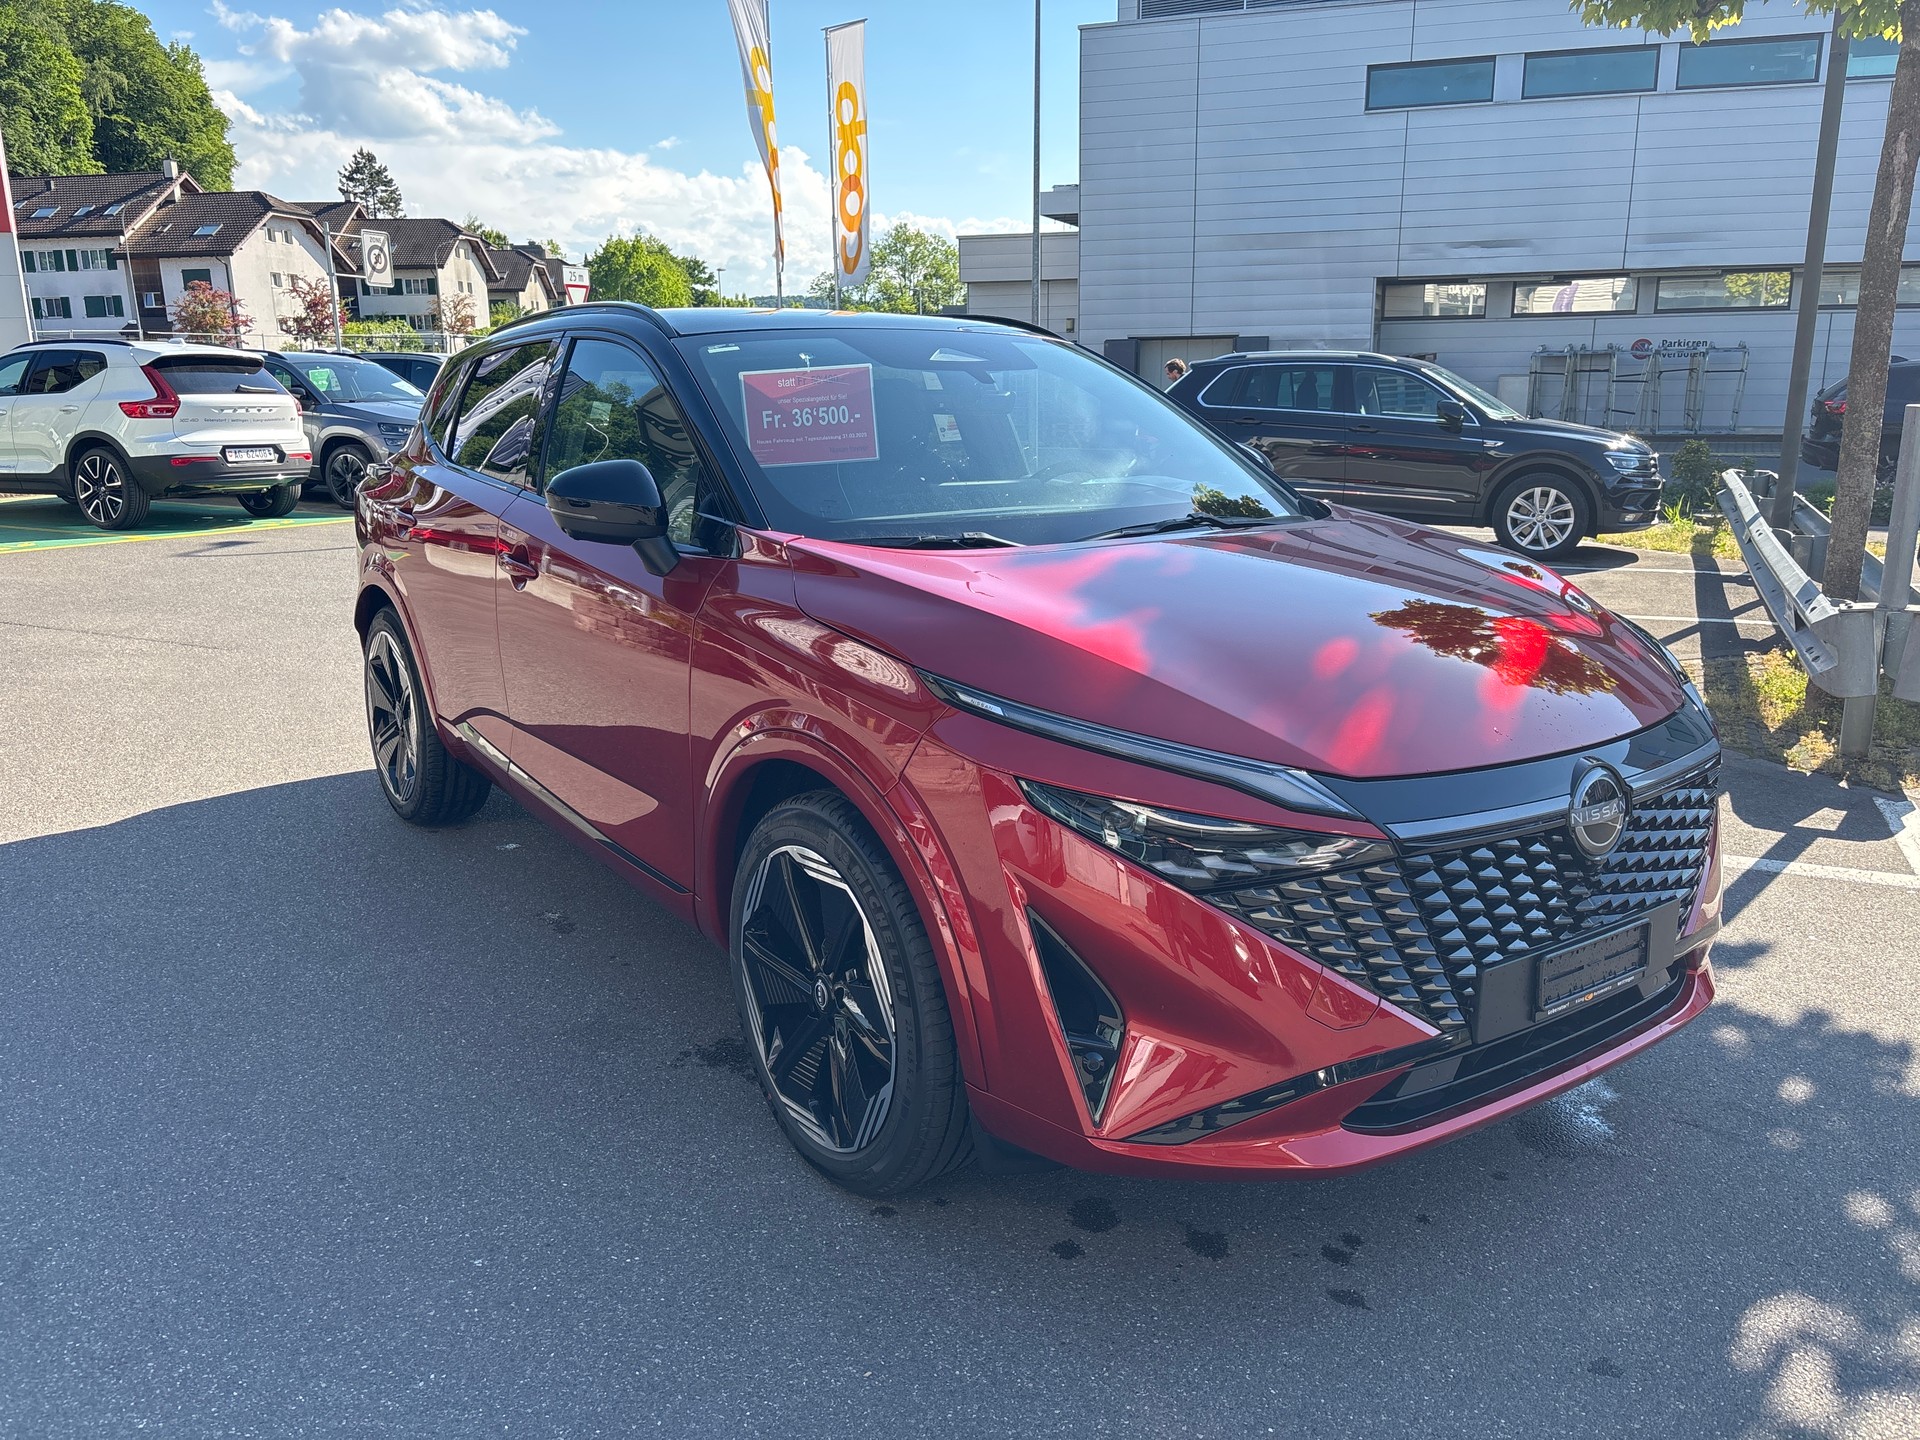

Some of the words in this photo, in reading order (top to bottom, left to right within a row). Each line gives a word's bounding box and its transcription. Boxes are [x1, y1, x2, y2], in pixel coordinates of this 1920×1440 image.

[835, 81, 867, 275] coop
[373, 252, 383, 265] 30
[568, 271, 577, 282] 25
[578, 274, 584, 282] m
[1661, 339, 1708, 348] Parkieren
[777, 378, 796, 388] statt
[777, 397, 792, 405] unser
[792, 395, 829, 405] Spezialangebot
[762, 410, 787, 429] Fr.
[804, 434, 841, 443] Tageszulassung
[234, 449, 243, 459] AG
[246, 448, 268, 459] 62408
[970, 699, 994, 710] NISSAN
[1571, 797, 1626, 825] NISSAN
[850, 864, 911, 1008] MICHELIN
